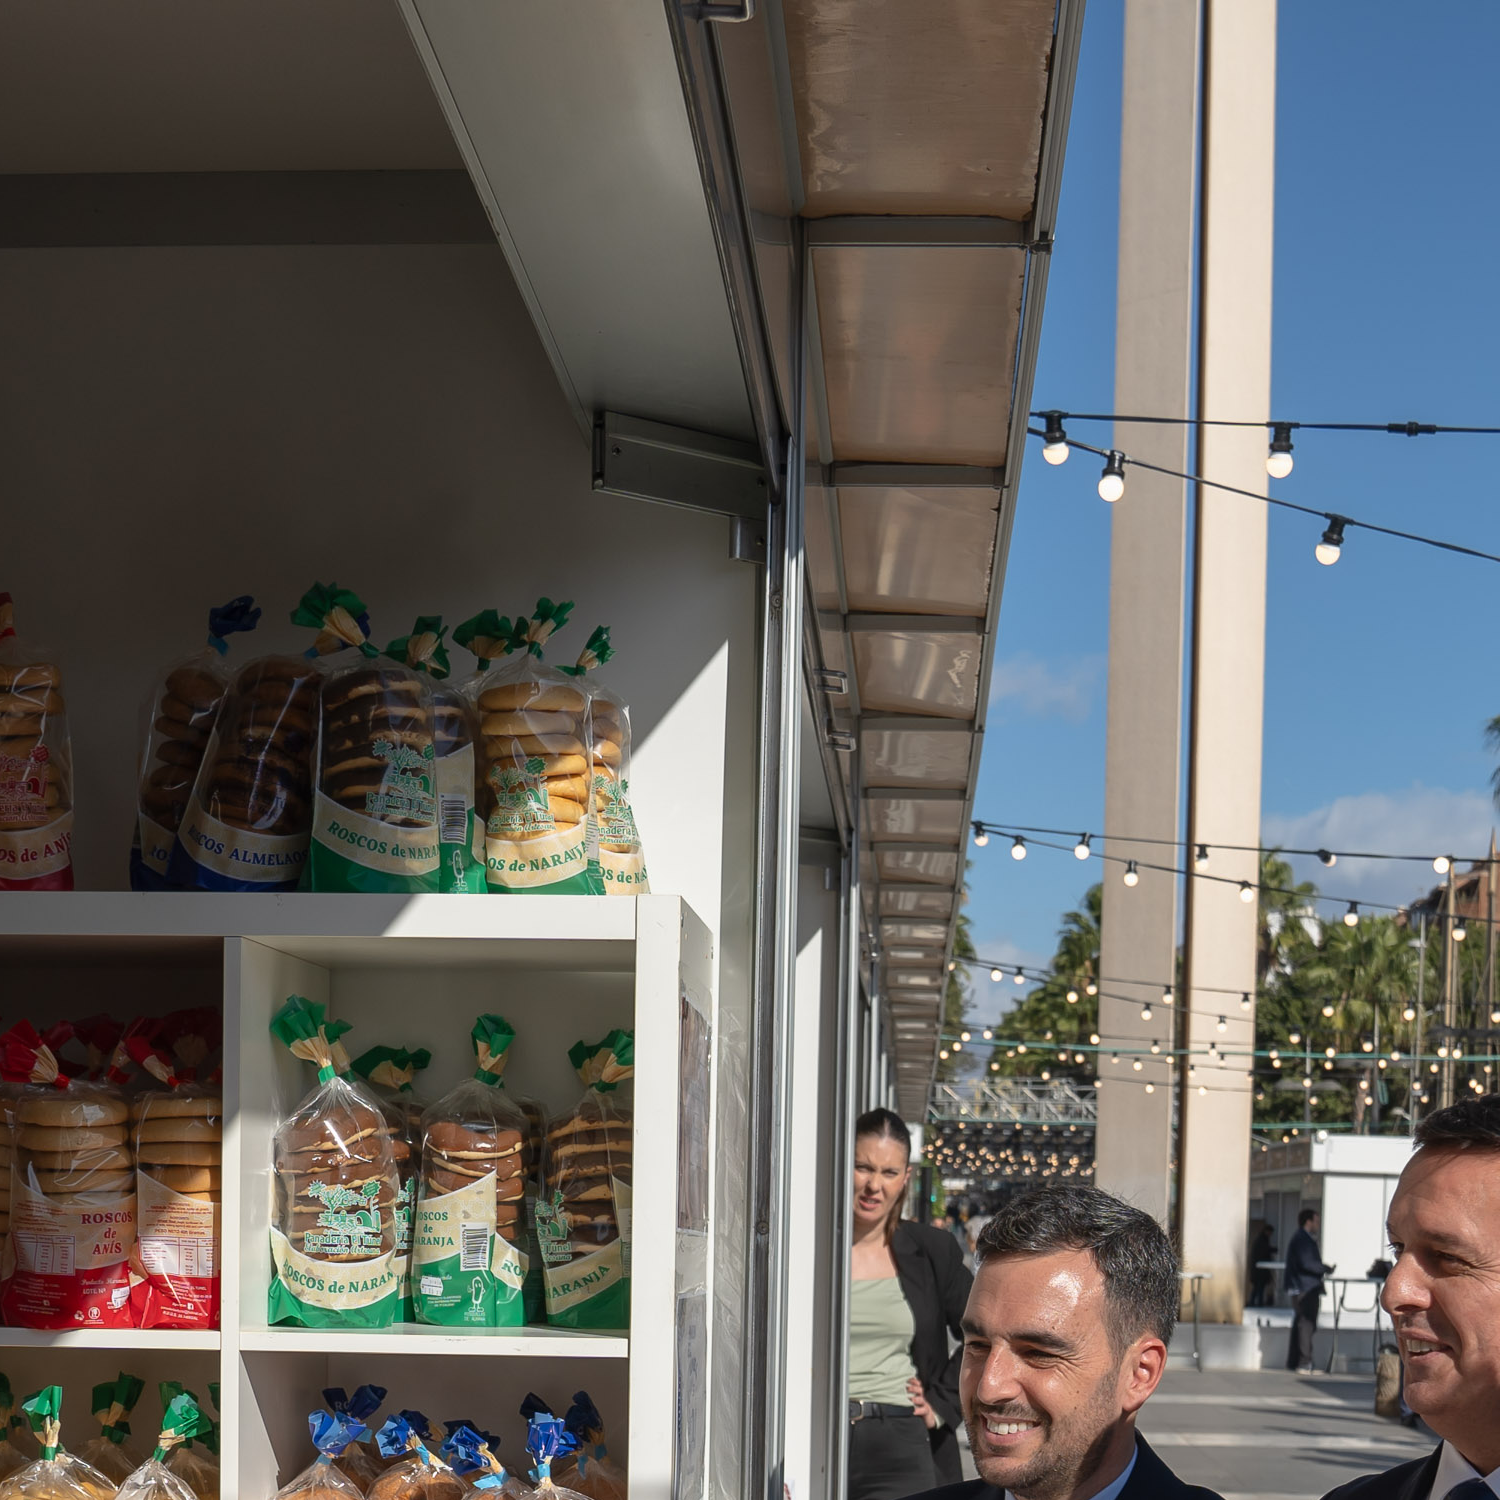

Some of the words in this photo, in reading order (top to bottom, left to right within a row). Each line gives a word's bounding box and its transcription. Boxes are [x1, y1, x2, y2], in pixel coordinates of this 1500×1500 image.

[327, 821, 388, 854] ROSCOS
[391, 844, 406, 858] de
[408, 844, 439, 859] NARA
[21, 849, 38, 862] de
[509, 858, 526, 871] de
[616, 870, 633, 884] de
[81, 1211, 132, 1224] ROSCOS
[104, 1228, 116, 1239] de
[423, 1224, 433, 1233] de
[92, 1241, 122, 1255] ANÍS
[328, 1281, 345, 1293] de
